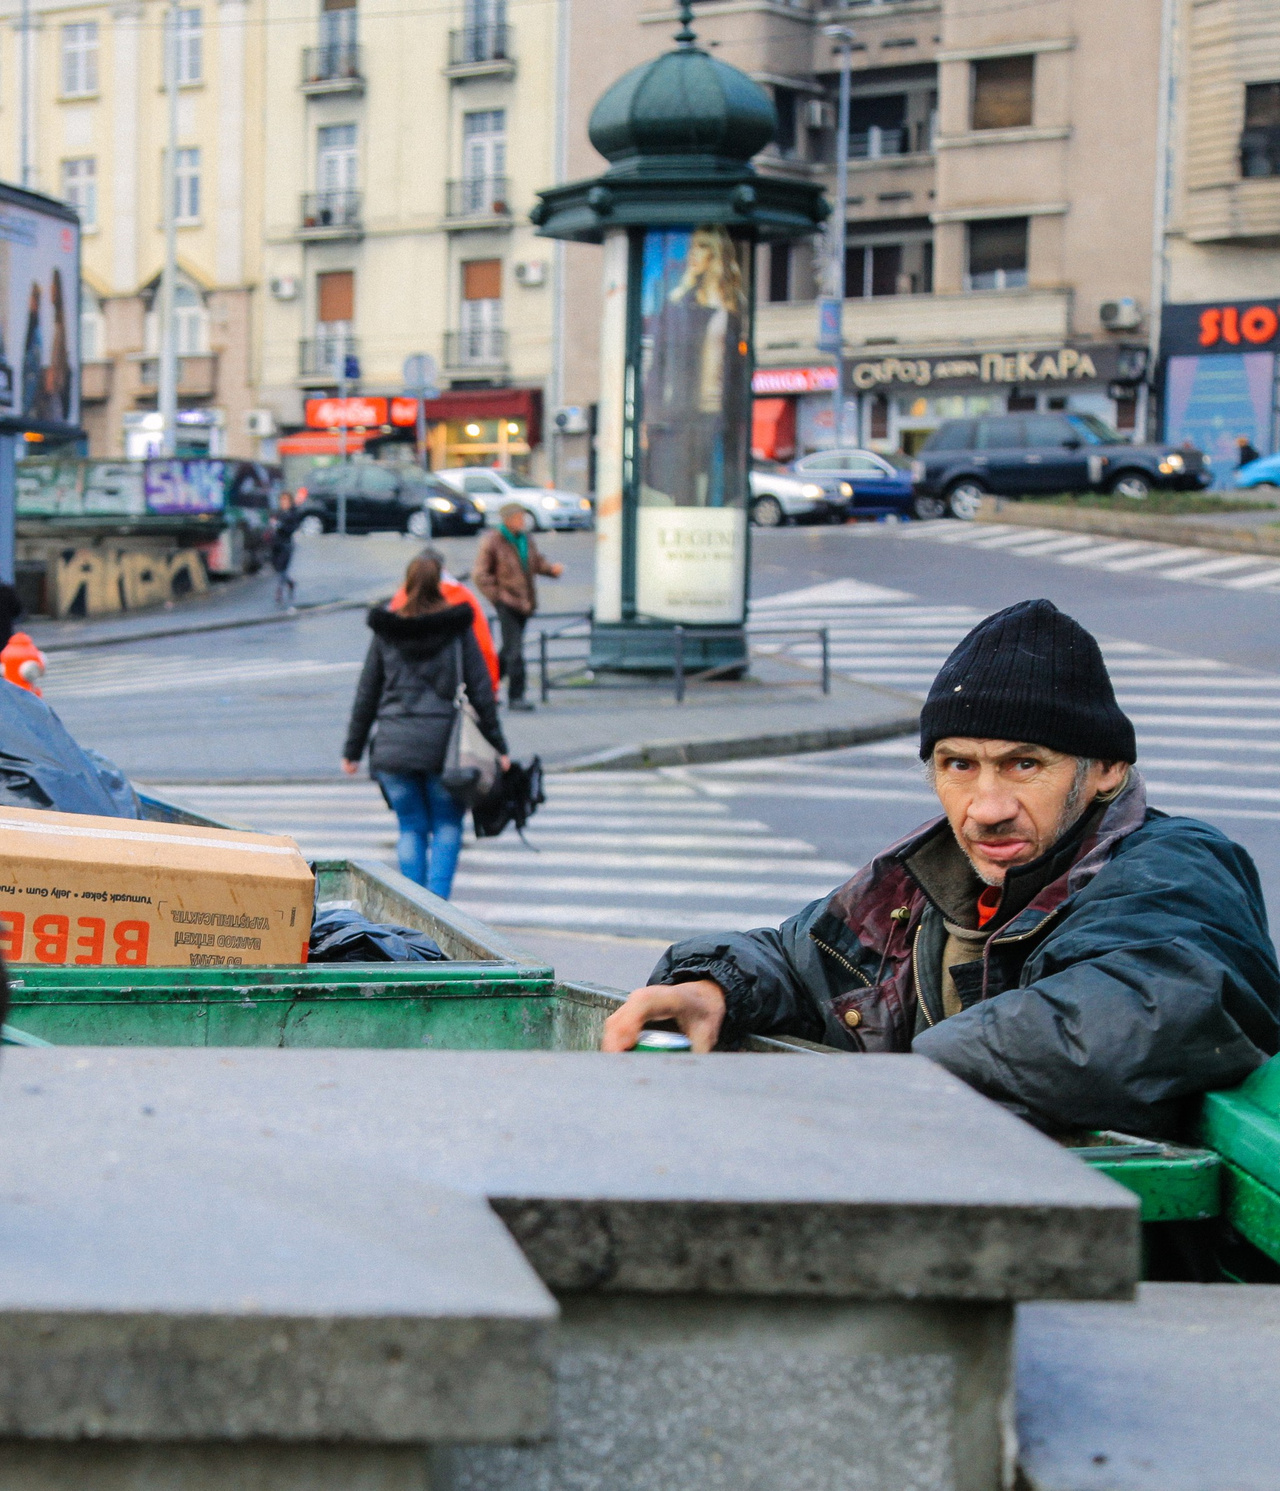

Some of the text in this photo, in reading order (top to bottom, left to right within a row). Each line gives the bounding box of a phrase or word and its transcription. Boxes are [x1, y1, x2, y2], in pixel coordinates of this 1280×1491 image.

[1198, 305, 1280, 347] SLO
[26, 887, 49, 897] Gum
[51, 887, 71, 899] Jelly
[81, 891, 108, 902] Şeker
[110, 893, 152, 904] Yumuşak
[174, 931, 262, 950] BARKOD ETİKETİ
